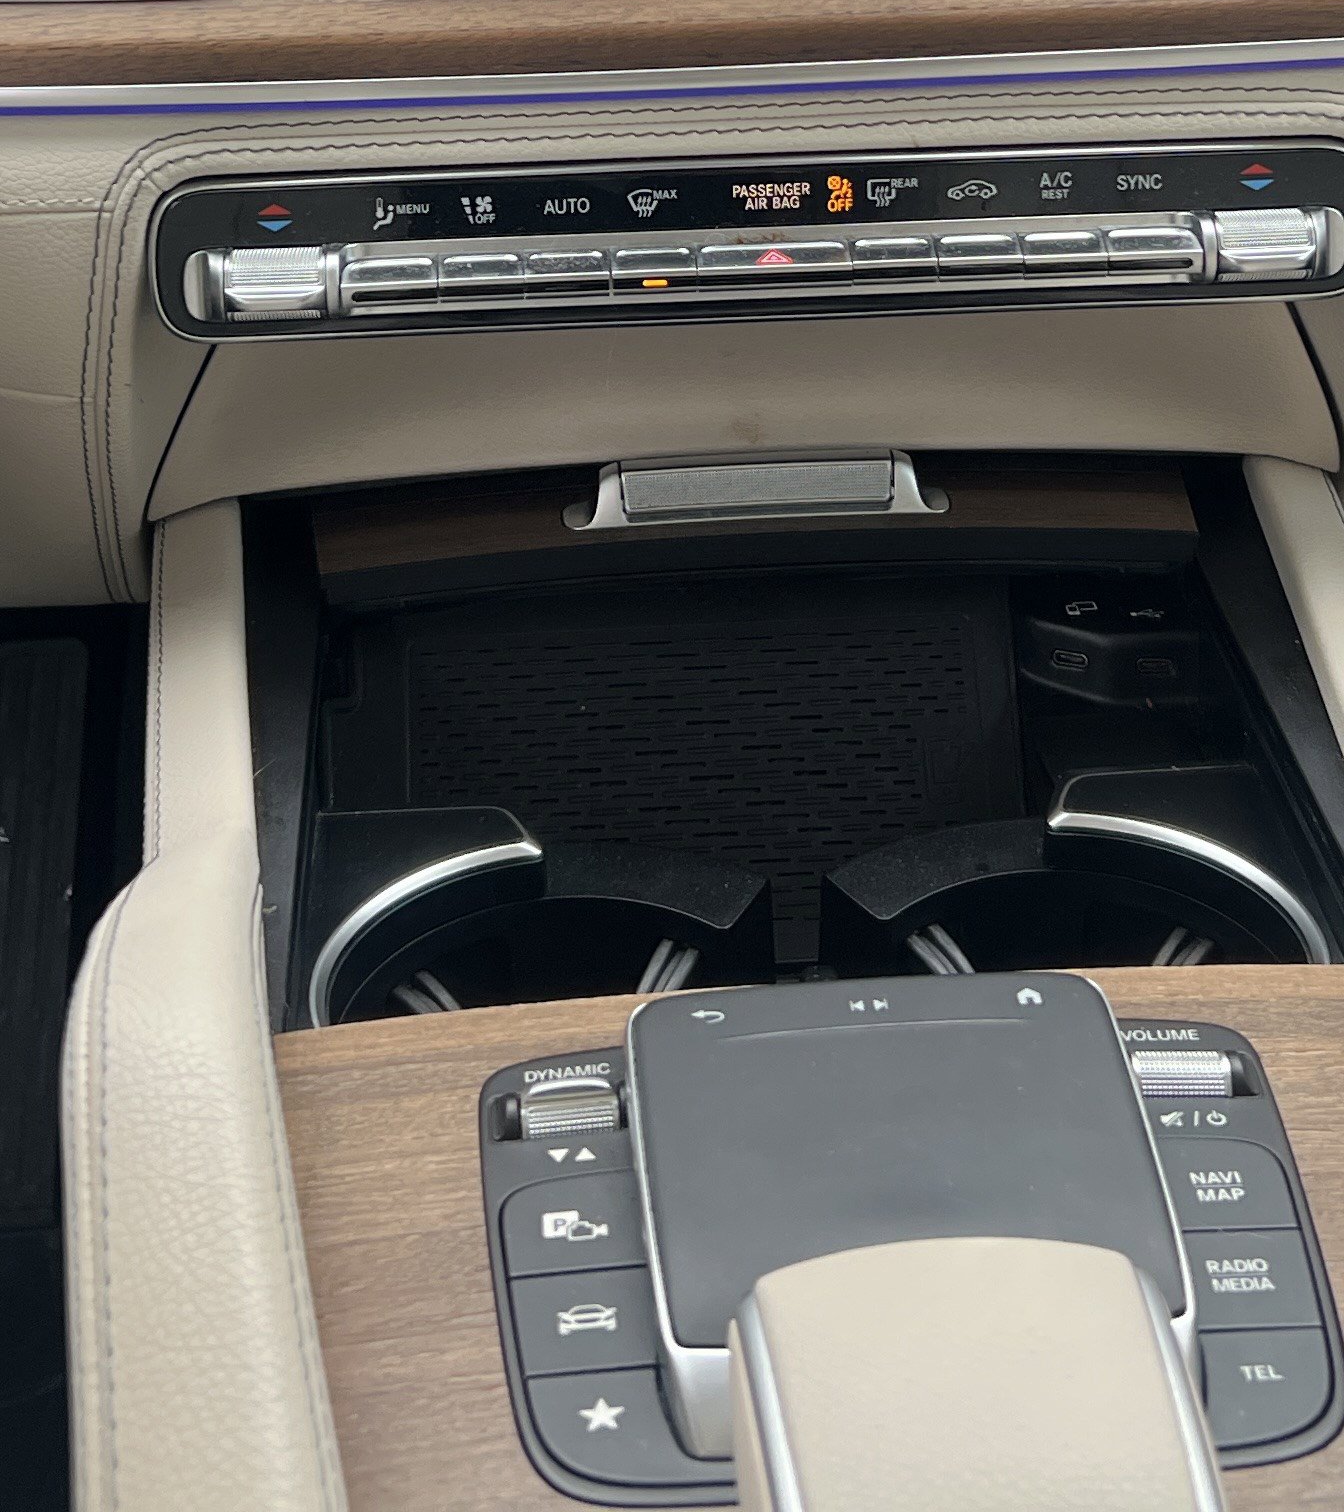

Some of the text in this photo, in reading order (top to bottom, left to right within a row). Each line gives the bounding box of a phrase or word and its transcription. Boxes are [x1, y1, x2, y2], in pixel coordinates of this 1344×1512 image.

[890, 177, 919, 188] REAR
[1039, 171, 1073, 189] A/C
[1116, 173, 1163, 191] SYNC
[652, 189, 678, 200] MAX
[732, 182, 811, 198] PASSENGER
[1041, 188, 1069, 200] REST
[396, 203, 430, 215] MENU
[543, 197, 591, 215] AUTO
[745, 195, 800, 211] AIR BAG
[827, 198, 854, 213] OFF
[474, 212, 496, 225] OFF
[1119, 1028, 1200, 1042] VOLUME
[524, 1062, 611, 1083] DYNAMIC
[1189, 1170, 1242, 1185] NAVI
[1196, 1187, 1245, 1202] MAP
[1205, 1257, 1269, 1274] RADIO
[1211, 1276, 1276, 1293] MEDIA
[1239, 1364, 1285, 1382] TEL
